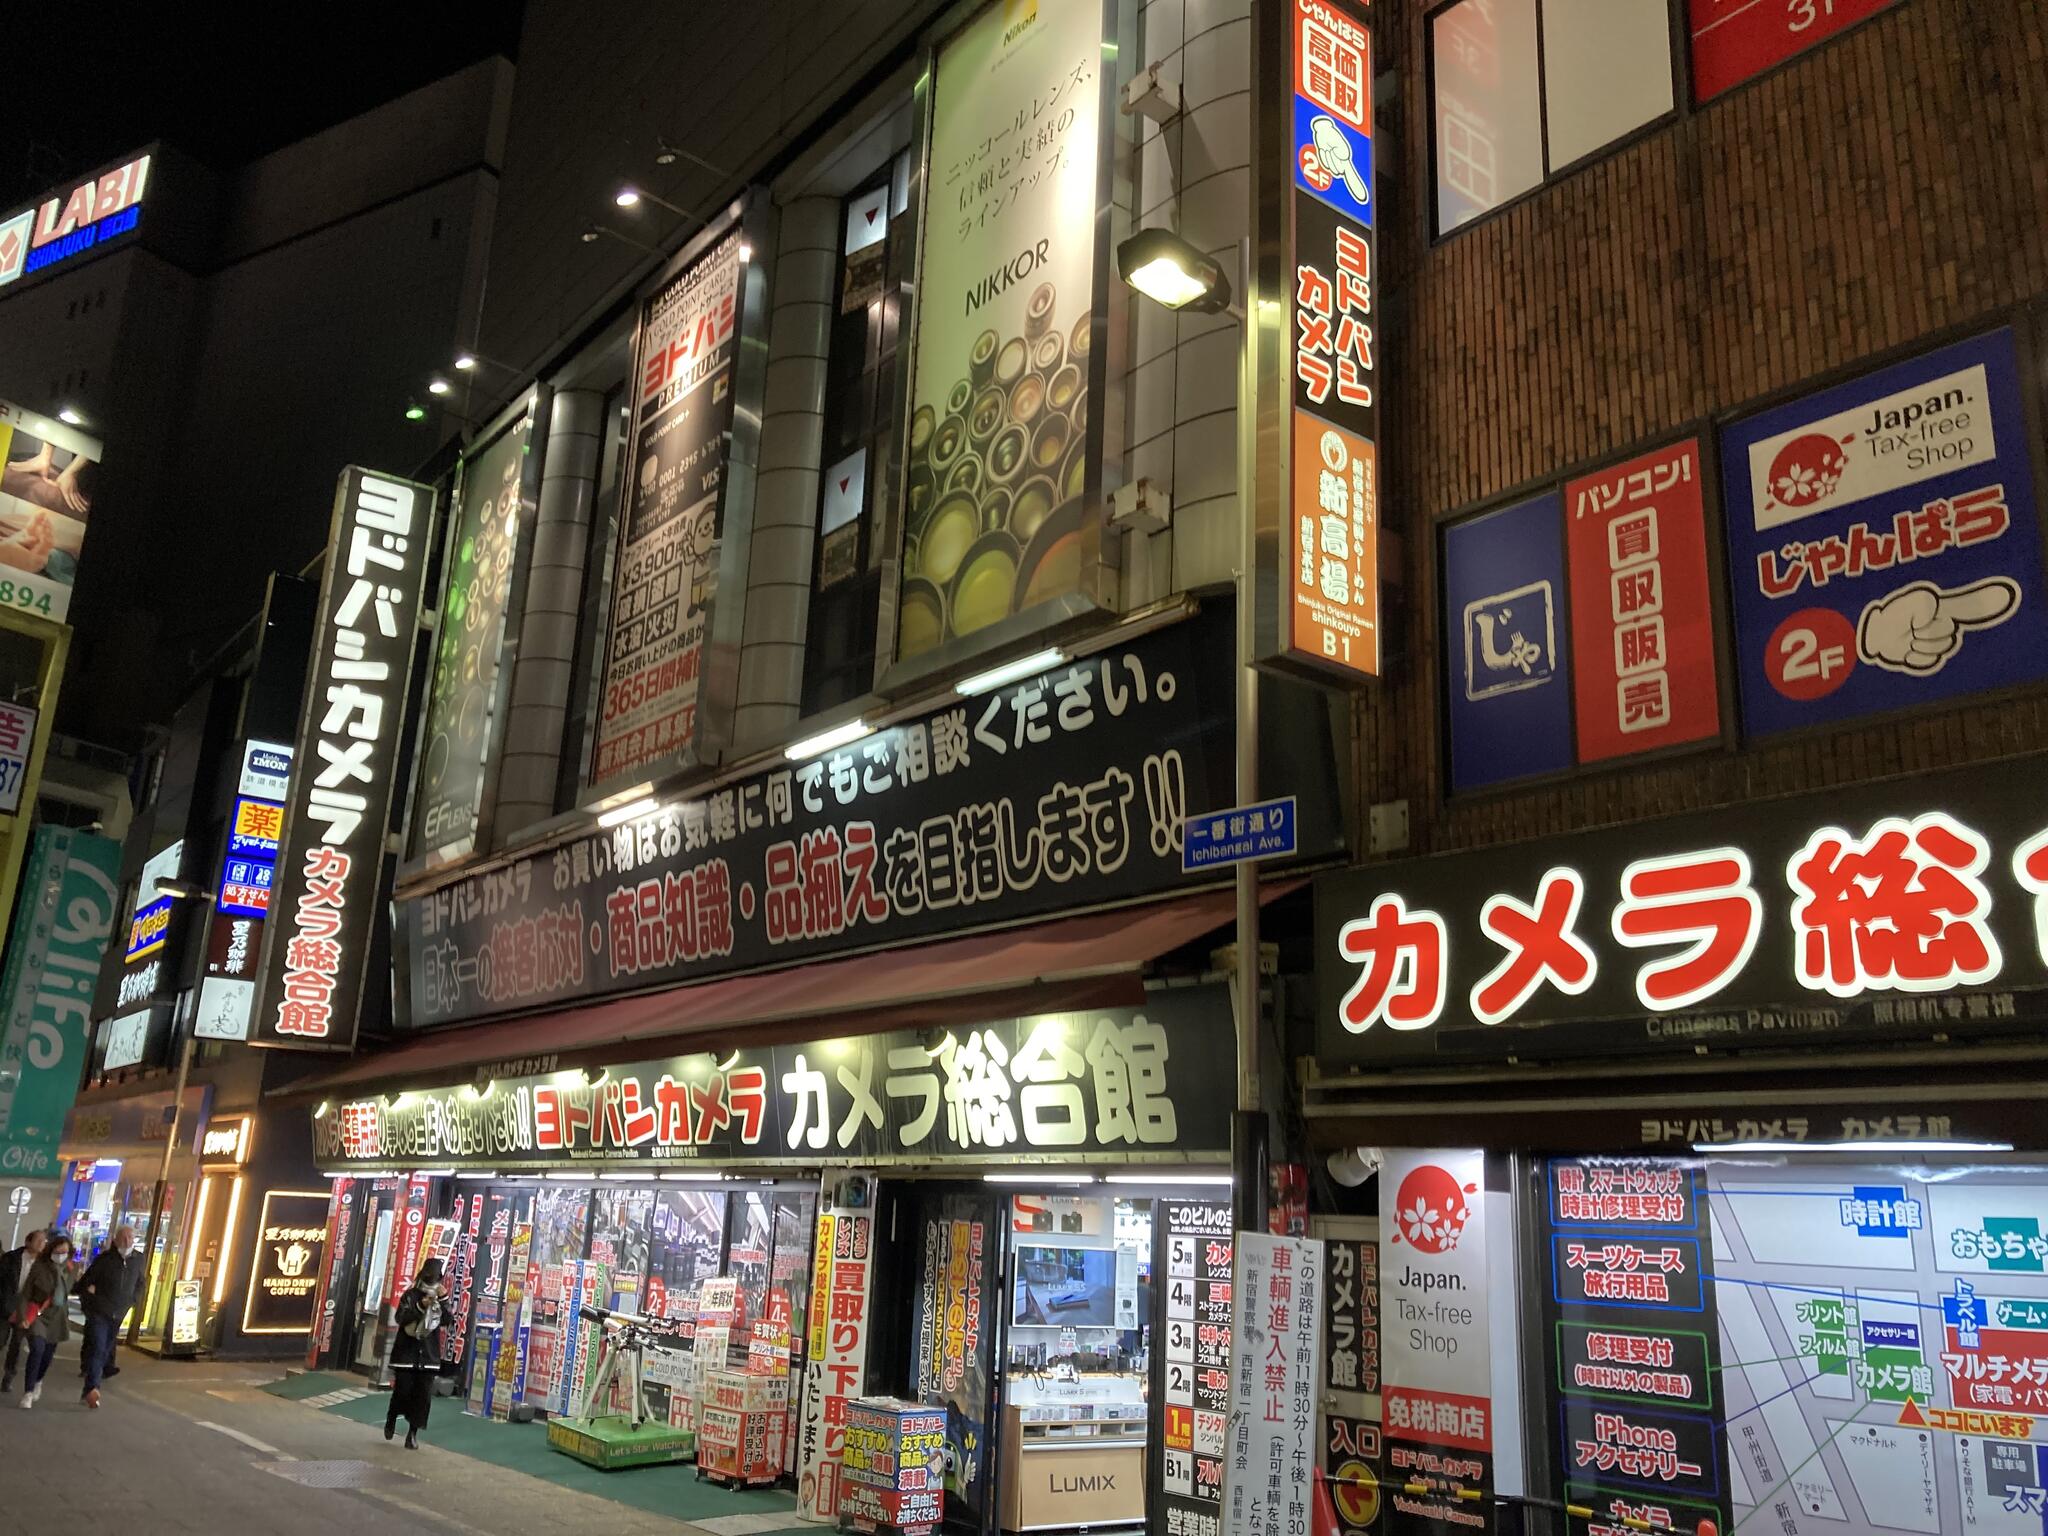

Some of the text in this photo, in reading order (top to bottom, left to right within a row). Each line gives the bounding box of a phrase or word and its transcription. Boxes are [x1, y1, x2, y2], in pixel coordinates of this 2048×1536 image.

[1003, 12, 1037, 47] Nikon
[1308, 25, 1358, 85] 高価
[1308, 60, 1359, 117] 買取
[946, 59, 1092, 186] ニッコールレンズ、
[959, 107, 1075, 212] 信頼と実績の
[1303, 150, 1330, 189] 2F
[32, 155, 150, 249] LABI
[957, 146, 1070, 243] ラインアップ。
[964, 238, 1050, 317] NIKKOR
[653, 273, 728, 337] GOLD POINT CARD
[1335, 226, 1374, 408] ヨドバシ
[1297, 265, 1333, 405] カメラ
[657, 348, 721, 410] PREMIUM
[1864, 386, 1975, 437] Japan.
[1865, 411, 1972, 460] Tax-free
[1905, 435, 1975, 473] Shop
[1757, 484, 2011, 600] じゃんぱら
[1612, 511, 1668, 731] 買取販売
[307, 475, 416, 846] ヨドバシカメラ
[1780, 628, 1846, 683] 2F
[253, 757, 288, 772] IMON
[422, 653, 1176, 938] ヨドバシカメラ お買い物はお気軽に何でもご相談ください。
[242, 804, 280, 838] 薬
[448, 800, 473, 833] LENS
[1193, 811, 1284, 841] 一番街通り
[226, 884, 269, 901] 処方せん
[277, 845, 348, 1039] カメラ総合館
[1339, 810, 2048, 1035] カメラ総
[782, 1014, 1178, 1150] カメラ総合館
[533, 1066, 767, 1151] ヨドバシカメラ
[1640, 1114, 1952, 1143] ヨドバシカメラ カメラ館
[1559, 1166, 1683, 1194] 時計 スマートウォッチ
[1560, 1194, 1685, 1222] 時計修理受付
[1840, 1199, 1922, 1231] 時計館
[1567, 1244, 1685, 1272] スーツケース
[263, 1278, 316, 1288] HAND DRIP
[270, 1287, 307, 1297] COFFEE
[1399, 1265, 1467, 1294] Japan.
[1583, 1271, 1668, 1302] 旅行用品
[1330, 1242, 1358, 1389] カメラ館
[1360, 1244, 1379, 1393] ヨドバシカメラ
[1395, 1298, 1473, 1325] Tax-free
[1263, 1246, 1294, 1423] 車輌進入禁止
[1409, 1328, 1459, 1359] Shop
[1586, 1332, 1673, 1366] 修理受付
[1575, 1363, 1693, 1399] (時計以外の製品)
[1857, 1362, 1934, 1396] カメラ館
[1330, 1418, 1381, 1459] 入口
[1387, 1395, 1486, 1441] 免税商店
[1594, 1413, 1676, 1452] iPhone
[1928, 1408, 2036, 1438] ココにいます
[1391, 1448, 1484, 1481] ヨドバシカメラ
[1575, 1441, 1702, 1482] アクセサリー
[1049, 1473, 1118, 1494] LUMIX
